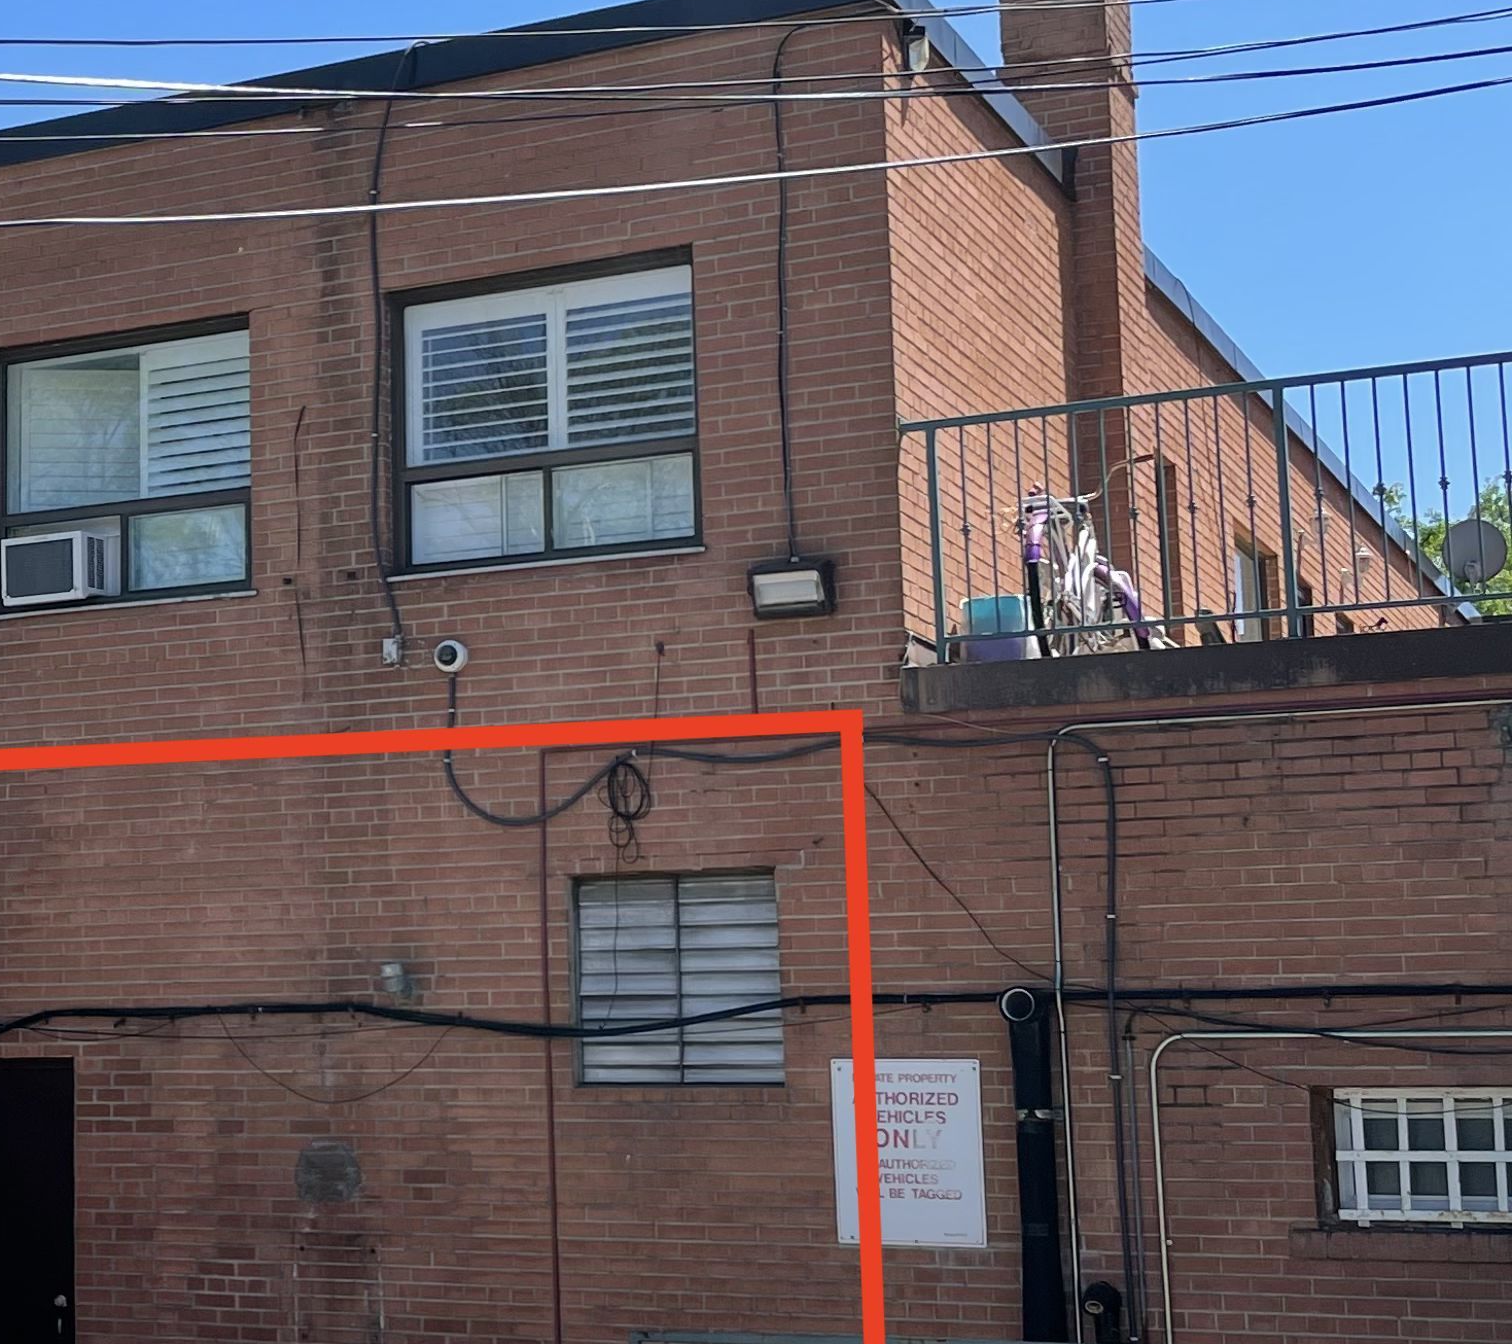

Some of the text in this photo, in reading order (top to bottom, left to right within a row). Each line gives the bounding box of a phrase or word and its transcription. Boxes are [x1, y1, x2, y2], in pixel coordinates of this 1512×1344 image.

[898, 1073, 957, 1083] PROPERTY
[853, 1091, 959, 1106] THORIZED
[877, 1110, 947, 1125] EHICLES
[889, 1188, 905, 1198] BE
[911, 1188, 963, 1200] TAGGED
